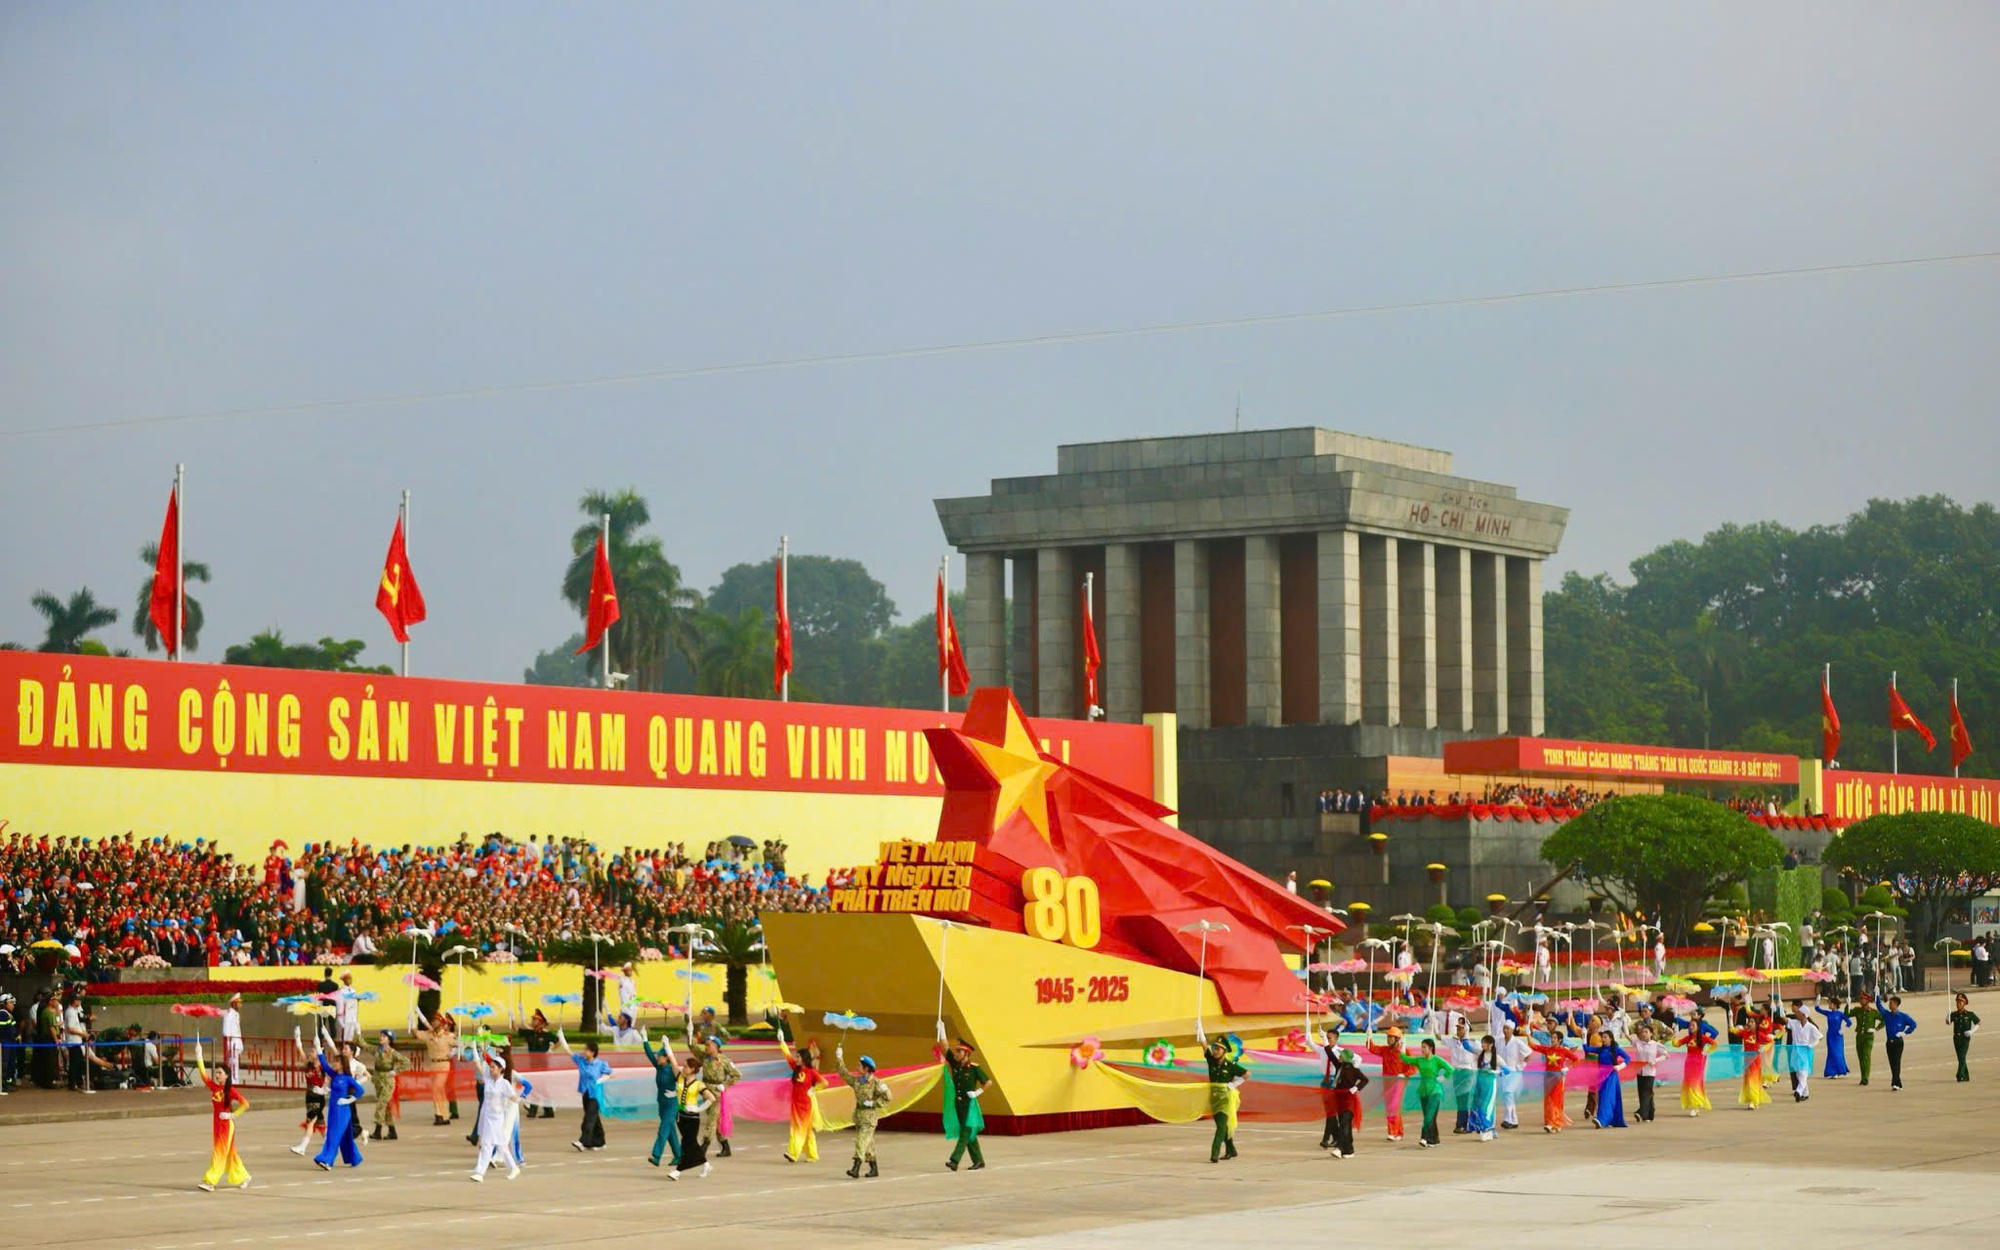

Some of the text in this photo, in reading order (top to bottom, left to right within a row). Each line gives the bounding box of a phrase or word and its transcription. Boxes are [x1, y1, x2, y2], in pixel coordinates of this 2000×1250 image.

[18, 664, 148, 752] ĐẢNG
[178, 679, 301, 768] CỘNG
[328, 684, 410, 762] SẢN
[434, 696, 524, 777] VIỆT
[548, 709, 626, 771] NAM
[649, 715, 767, 780] QUANG
[786, 724, 867, 781] VINH
[1836, 778, 1872, 819] NƯỚC
[923, 841, 976, 864] NAM
[1022, 866, 1101, 949] 80
[1035, 978, 1074, 1004] 1945
[1088, 976, 1129, 1002] 2025
